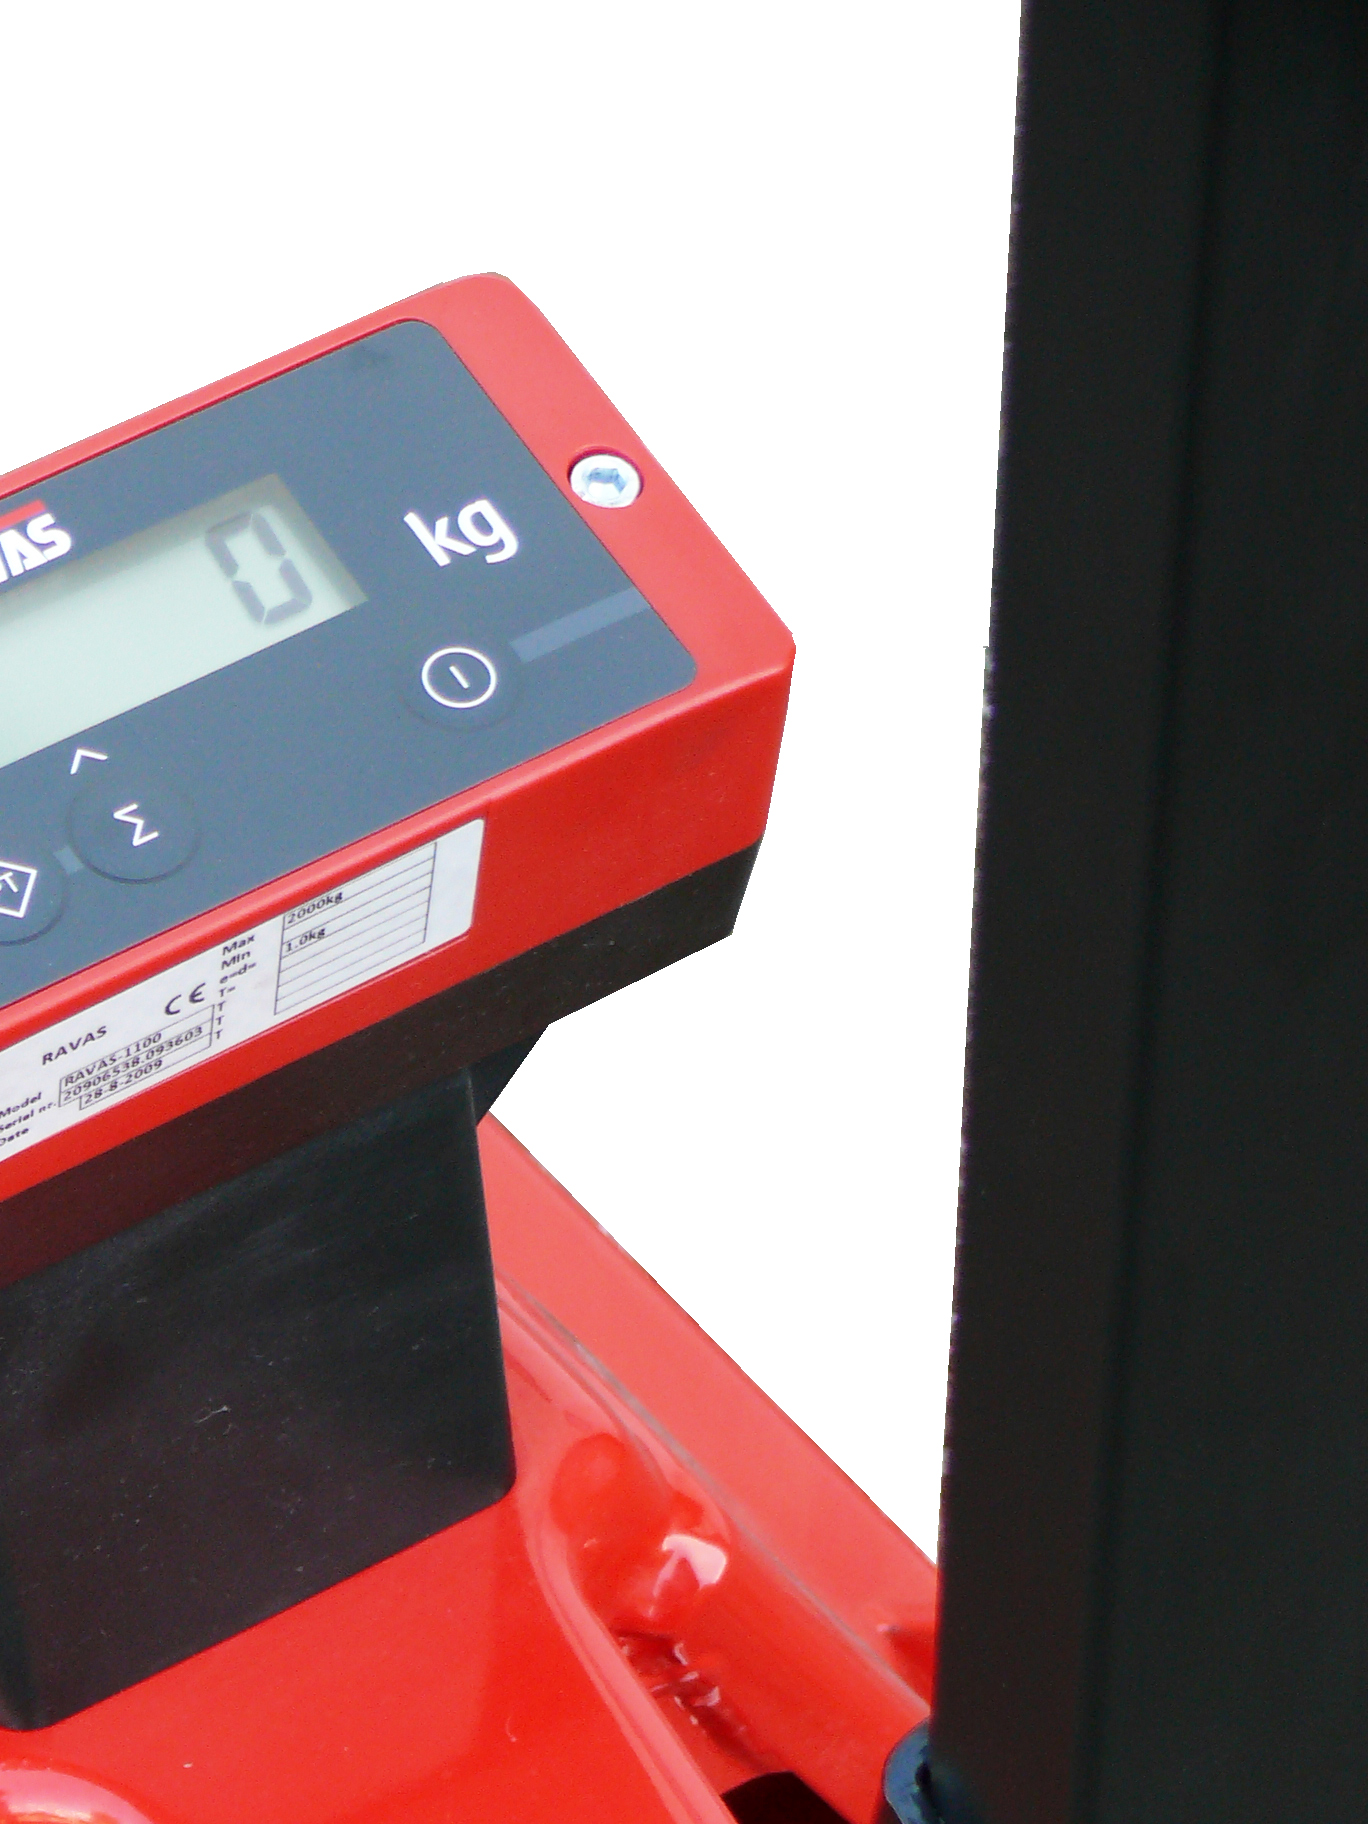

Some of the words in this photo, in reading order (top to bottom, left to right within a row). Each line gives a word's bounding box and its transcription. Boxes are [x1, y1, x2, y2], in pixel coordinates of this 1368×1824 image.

[403, 497, 520, 567] kg
[203, 511, 314, 626] 0
[222, 934, 255, 956] Max
[287, 892, 343, 924] 2000kg
[285, 928, 326, 952] 1.0kg
[221, 951, 251, 970] Min
[42, 1025, 108, 1066] RAVAS
[64, 1032, 162, 1087] RAVAS-1100
[84, 1059, 163, 1105] 28-8-2009
